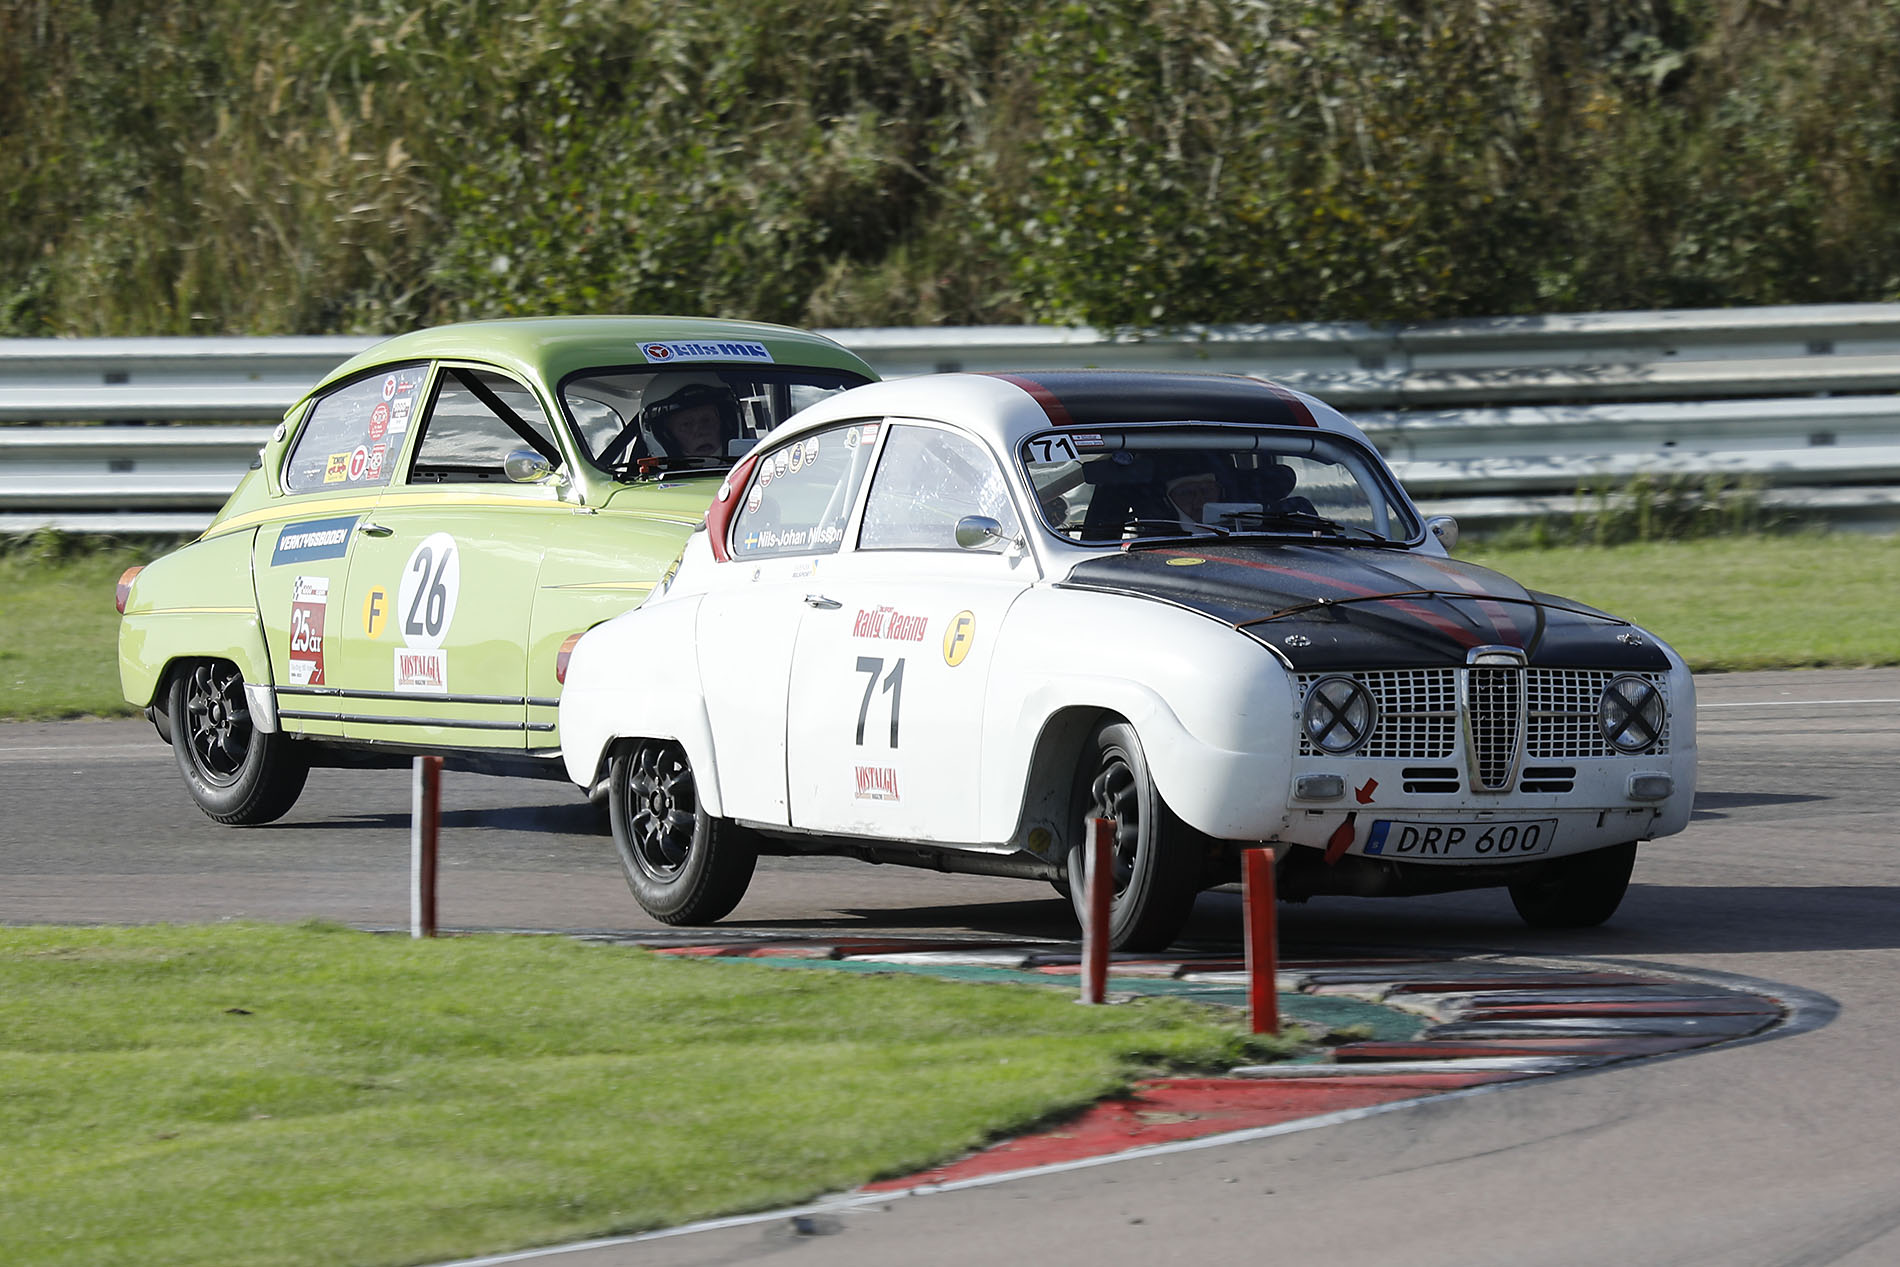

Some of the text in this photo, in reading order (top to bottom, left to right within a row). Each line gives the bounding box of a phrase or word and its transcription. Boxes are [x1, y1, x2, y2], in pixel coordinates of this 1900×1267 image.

[1032, 437, 1076, 462] 71
[280, 528, 348, 551] VERKTYGSBODEN
[757, 527, 843, 548] Nils-Johan Nilsson
[405, 546, 453, 637] 26
[368, 592, 384, 634] F
[853, 609, 928, 642] Rally Racing
[291, 608, 322, 653] 25 år
[949, 618, 970, 658] F
[399, 655, 441, 684] NOSTALGIA
[855, 656, 906, 749] 71
[855, 766, 900, 799] NOSTALGIA
[1396, 824, 1541, 855] DRP 600
